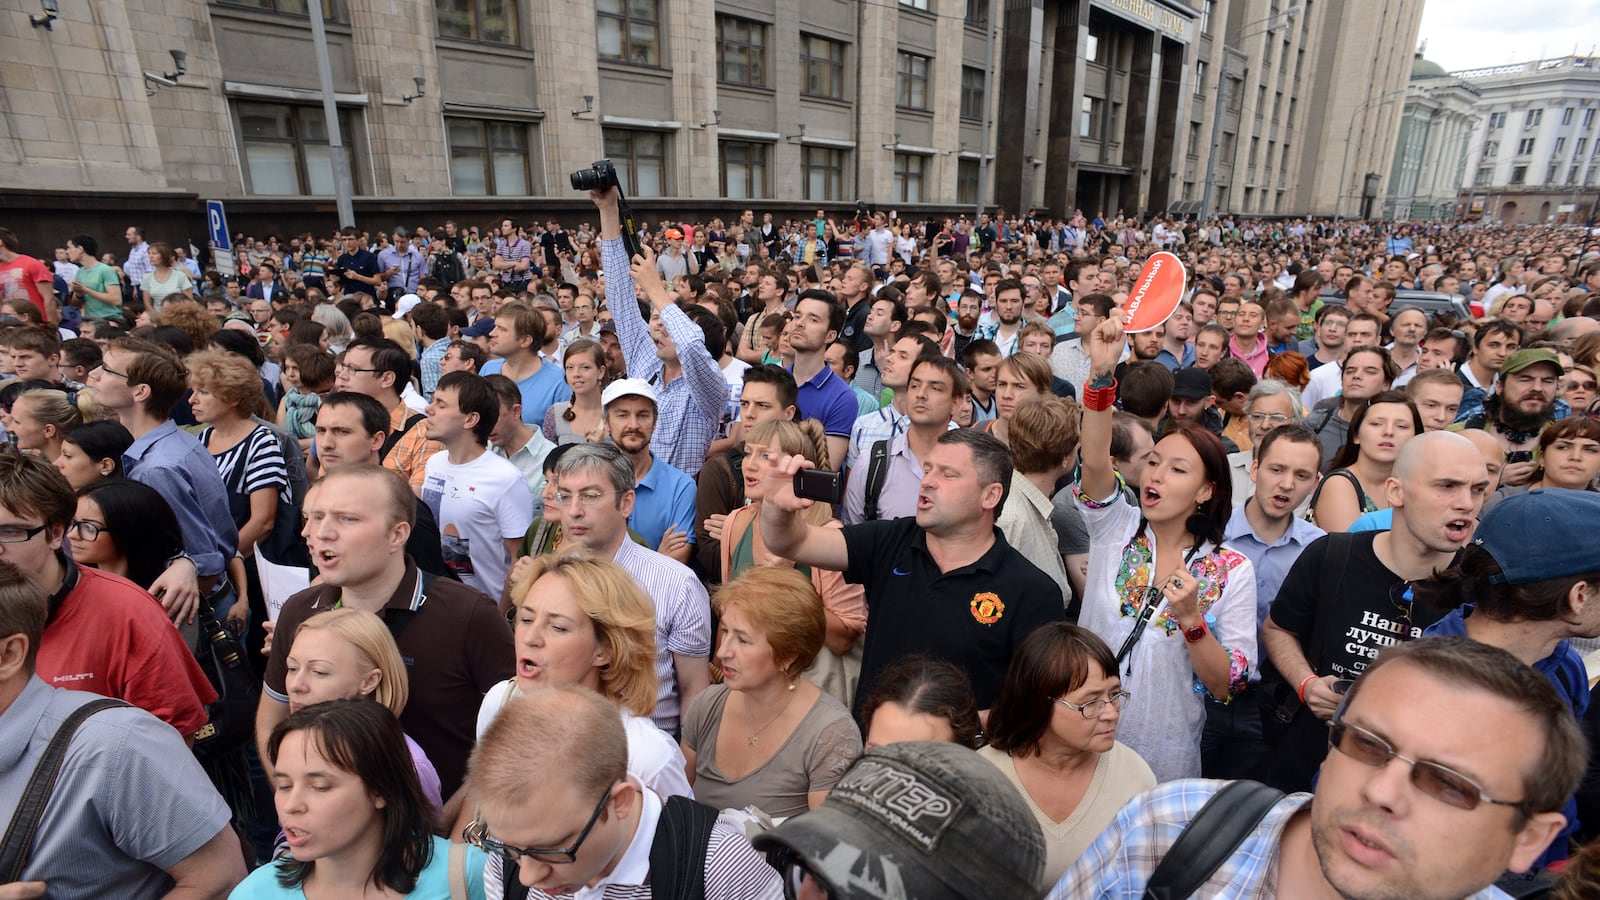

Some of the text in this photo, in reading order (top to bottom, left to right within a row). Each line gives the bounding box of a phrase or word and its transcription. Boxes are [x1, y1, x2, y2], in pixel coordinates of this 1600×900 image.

[1111, 0, 1185, 34] ВЕННАЯ ДУМА
[210, 208, 221, 241] P
[1125, 259, 1164, 325] НАВАЛЬНЫЙ
[1360, 610, 1423, 639] Наша
[53, 672, 94, 683] HILTI
